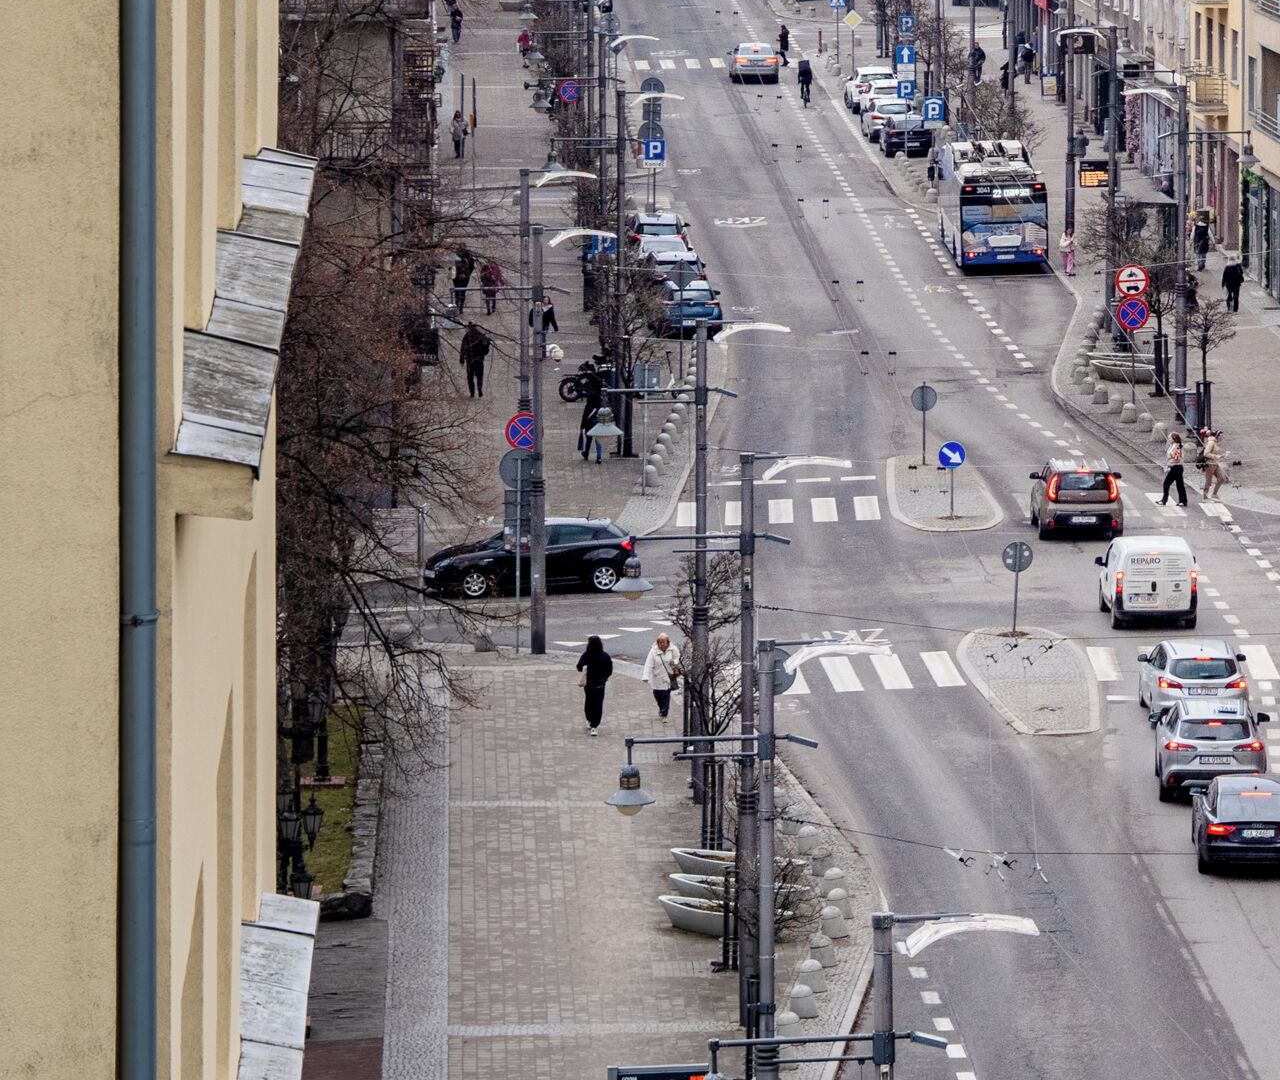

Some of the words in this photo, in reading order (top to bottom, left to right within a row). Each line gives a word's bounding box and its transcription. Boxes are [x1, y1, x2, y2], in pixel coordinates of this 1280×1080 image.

[900, 83, 911, 97] P
[928, 104, 940, 119] P
[649, 141, 662, 158] P
